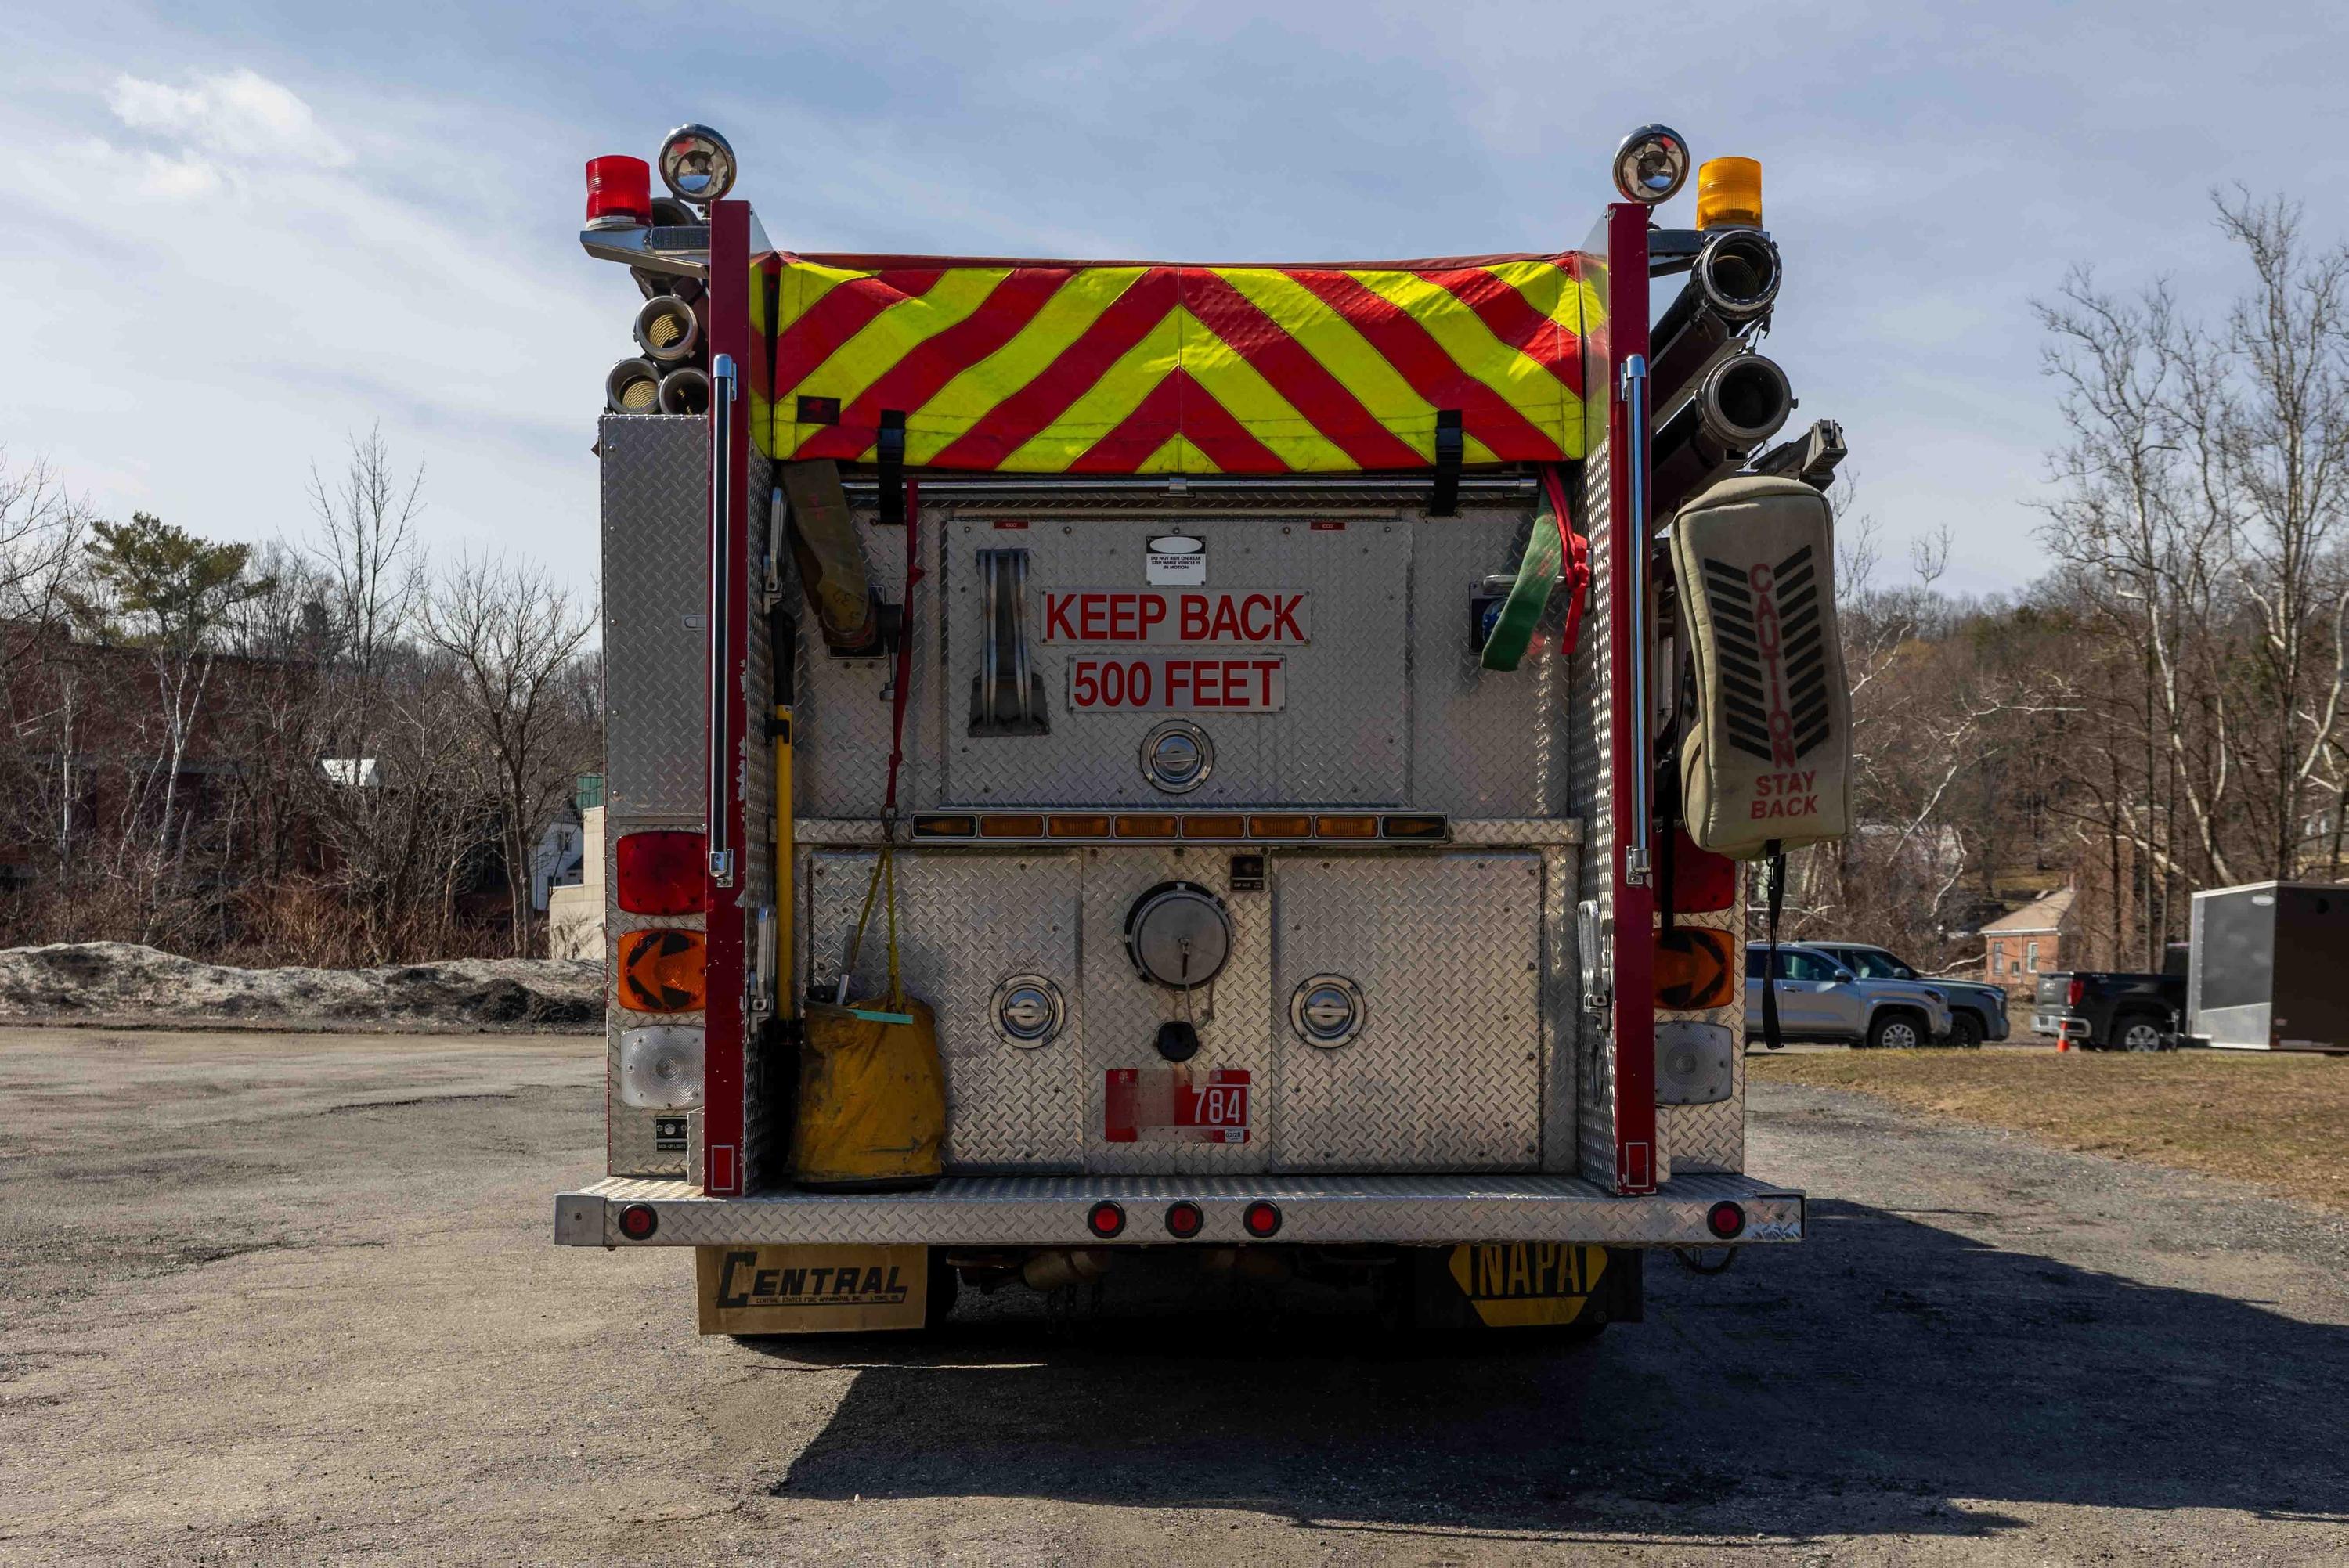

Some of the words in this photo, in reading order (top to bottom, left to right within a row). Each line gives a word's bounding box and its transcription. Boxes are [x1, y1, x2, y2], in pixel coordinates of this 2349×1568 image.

[1047, 593, 1167, 640] KEEP
[1180, 593, 1304, 640] BACK
[1074, 661, 1152, 707] 500
[1165, 661, 1280, 707] FEET
[1748, 563, 1795, 769] CAUTION
[1755, 770, 1817, 797] STAY
[1751, 795, 1819, 820] BACK
[1192, 1089, 1240, 1123] 784
[716, 1252, 907, 1308] CENTRAL
[1479, 1243, 1580, 1296] NAPA
